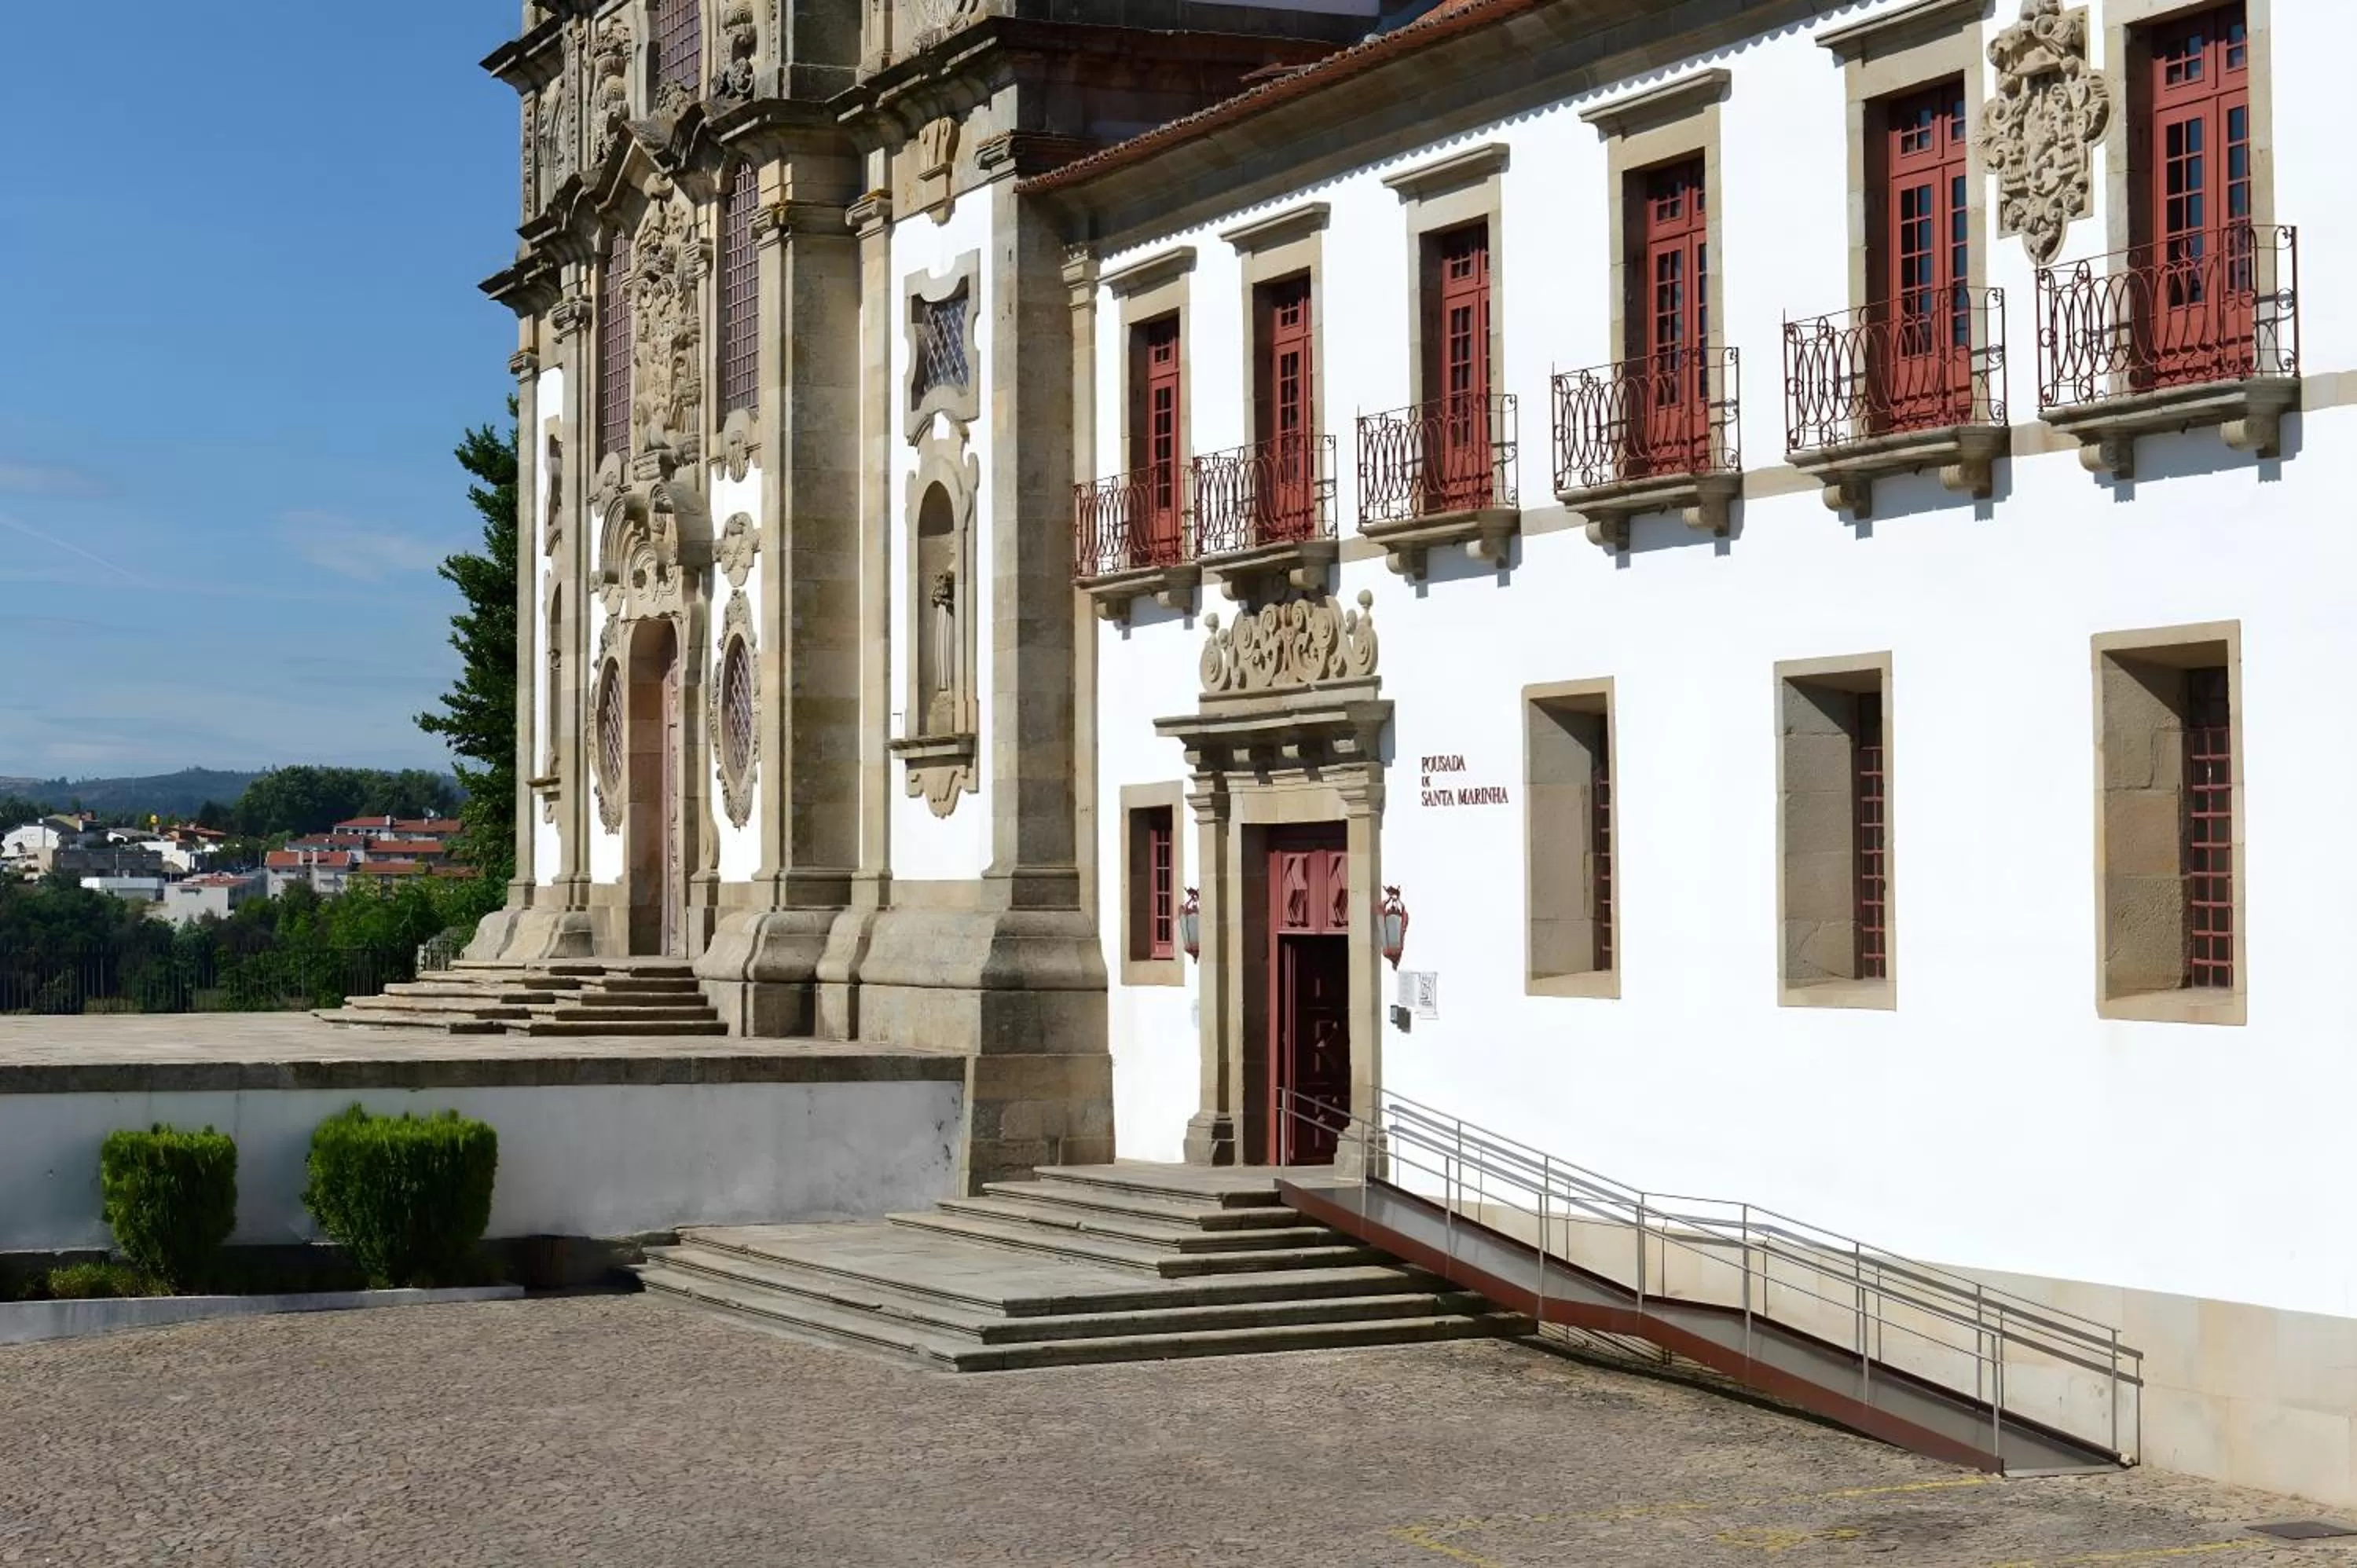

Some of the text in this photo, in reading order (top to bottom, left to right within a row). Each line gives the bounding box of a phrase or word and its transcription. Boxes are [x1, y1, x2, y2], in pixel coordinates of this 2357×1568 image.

[1422, 755, 1466, 773] POUSADA
[1422, 786, 1508, 807] SANTA MARINHA
